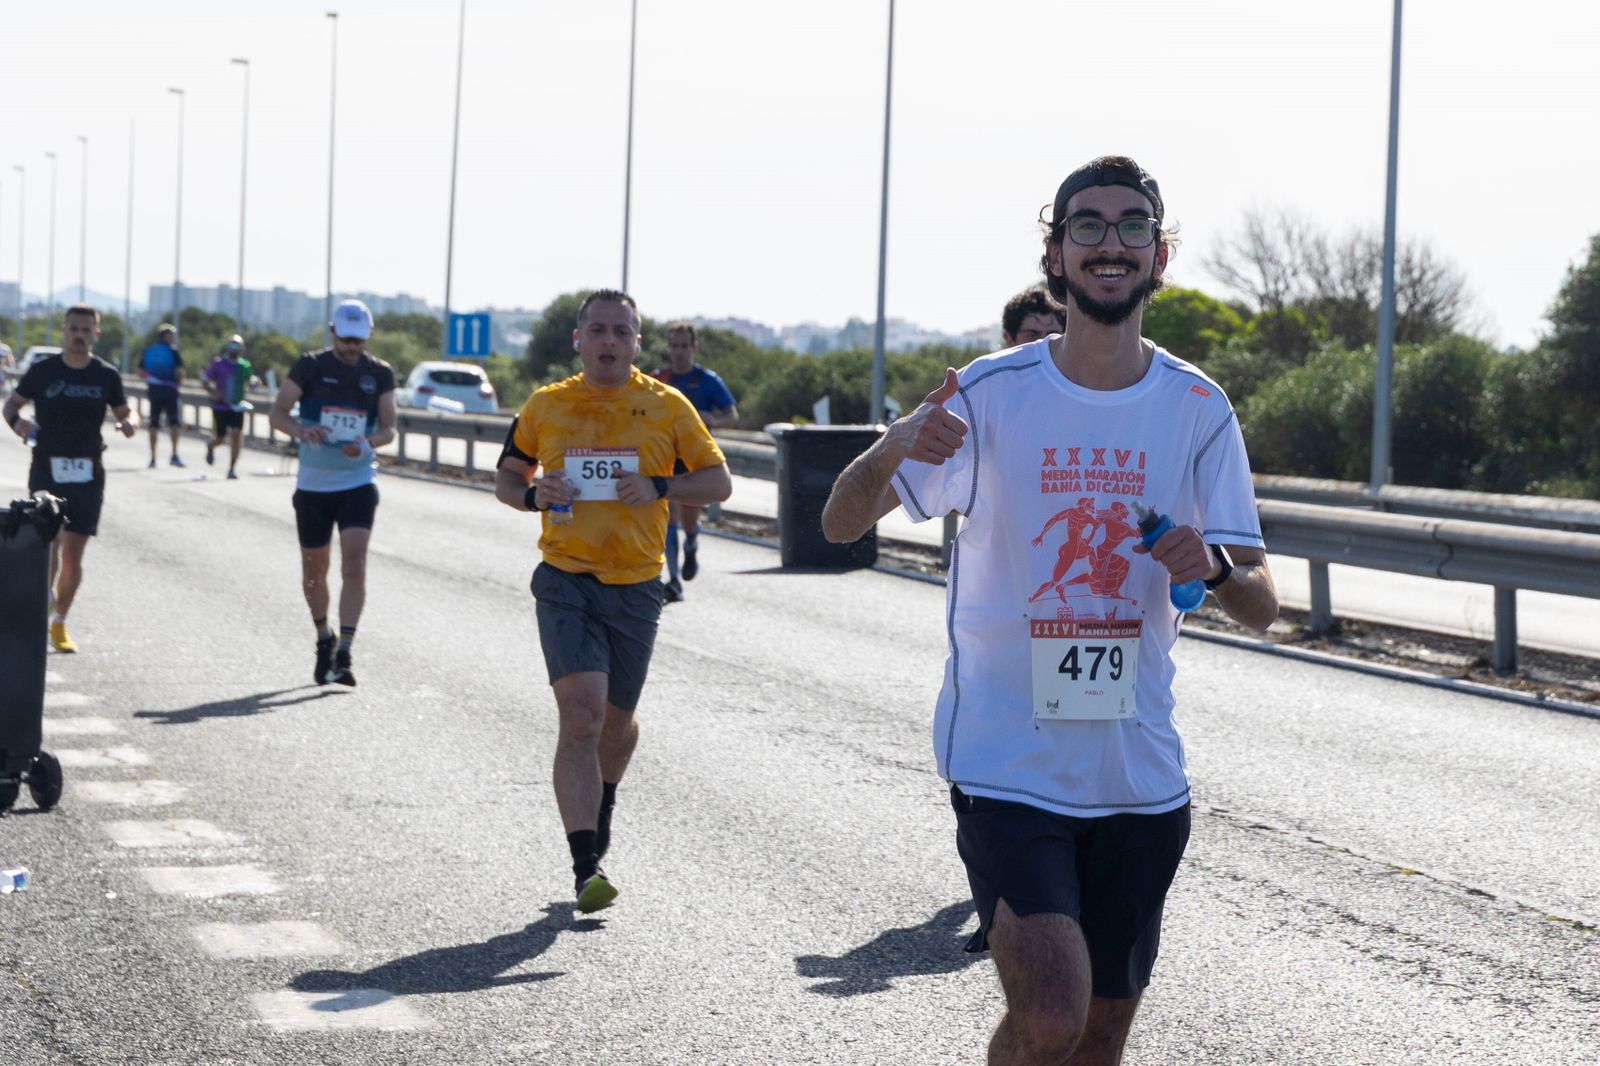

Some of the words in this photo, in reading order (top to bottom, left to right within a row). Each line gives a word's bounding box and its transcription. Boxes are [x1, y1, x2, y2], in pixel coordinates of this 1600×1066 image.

[332, 415, 358, 429] 712
[581, 460, 622, 480] 562
[1041, 468, 1081, 481] MEDIA
[1084, 469, 1146, 484] MARATÓN
[1058, 645, 1123, 681] 479
